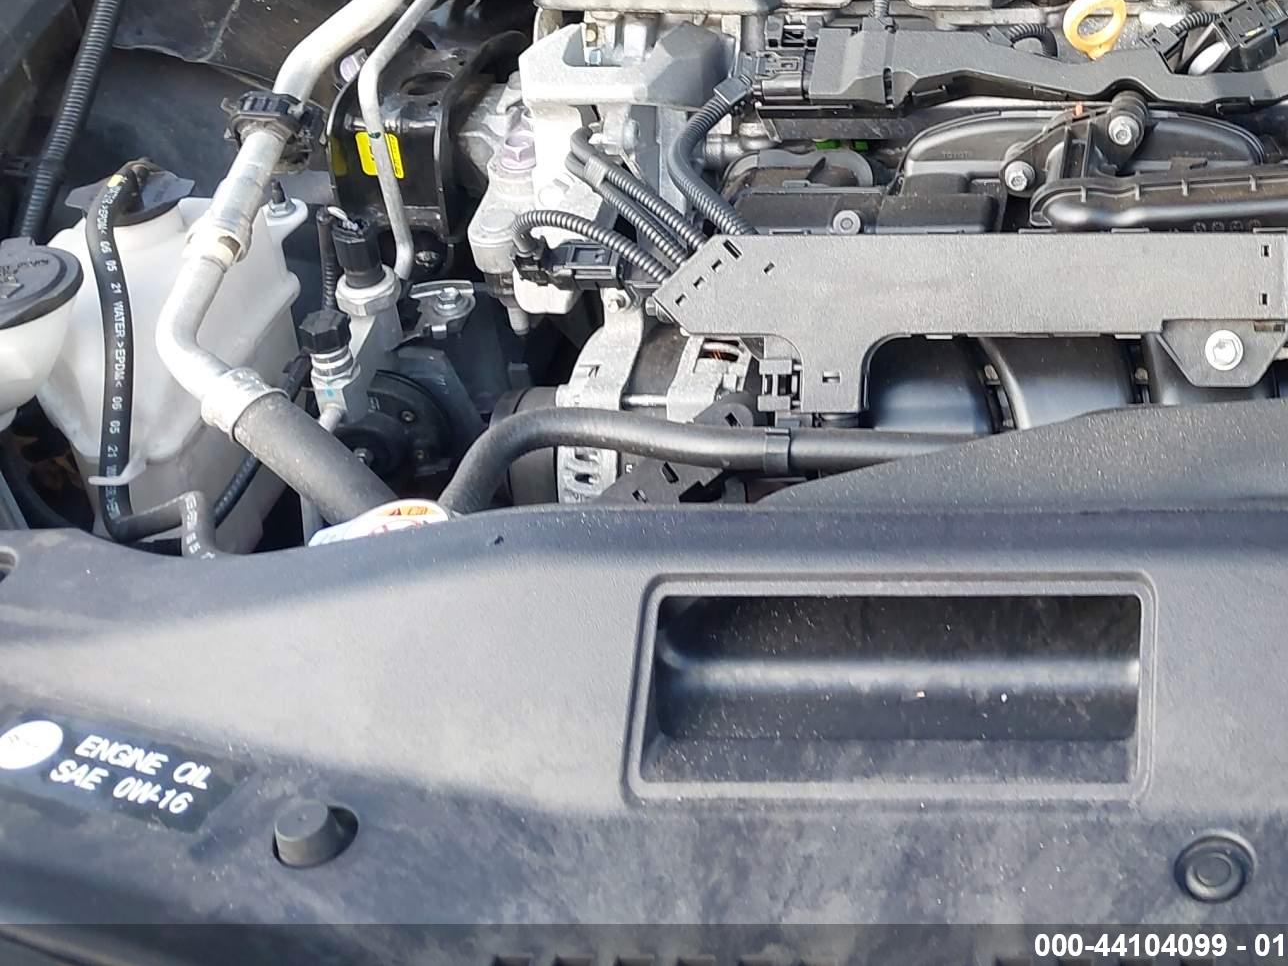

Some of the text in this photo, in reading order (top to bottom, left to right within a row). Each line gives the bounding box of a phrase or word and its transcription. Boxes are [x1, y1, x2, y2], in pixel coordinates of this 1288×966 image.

[111, 282, 122, 294] 21
[113, 301, 126, 338] WATER
[107, 445, 119, 458] 21
[75, 735, 212, 789] ENGINE OIL
[50, 760, 194, 814] SAE 0W-16
